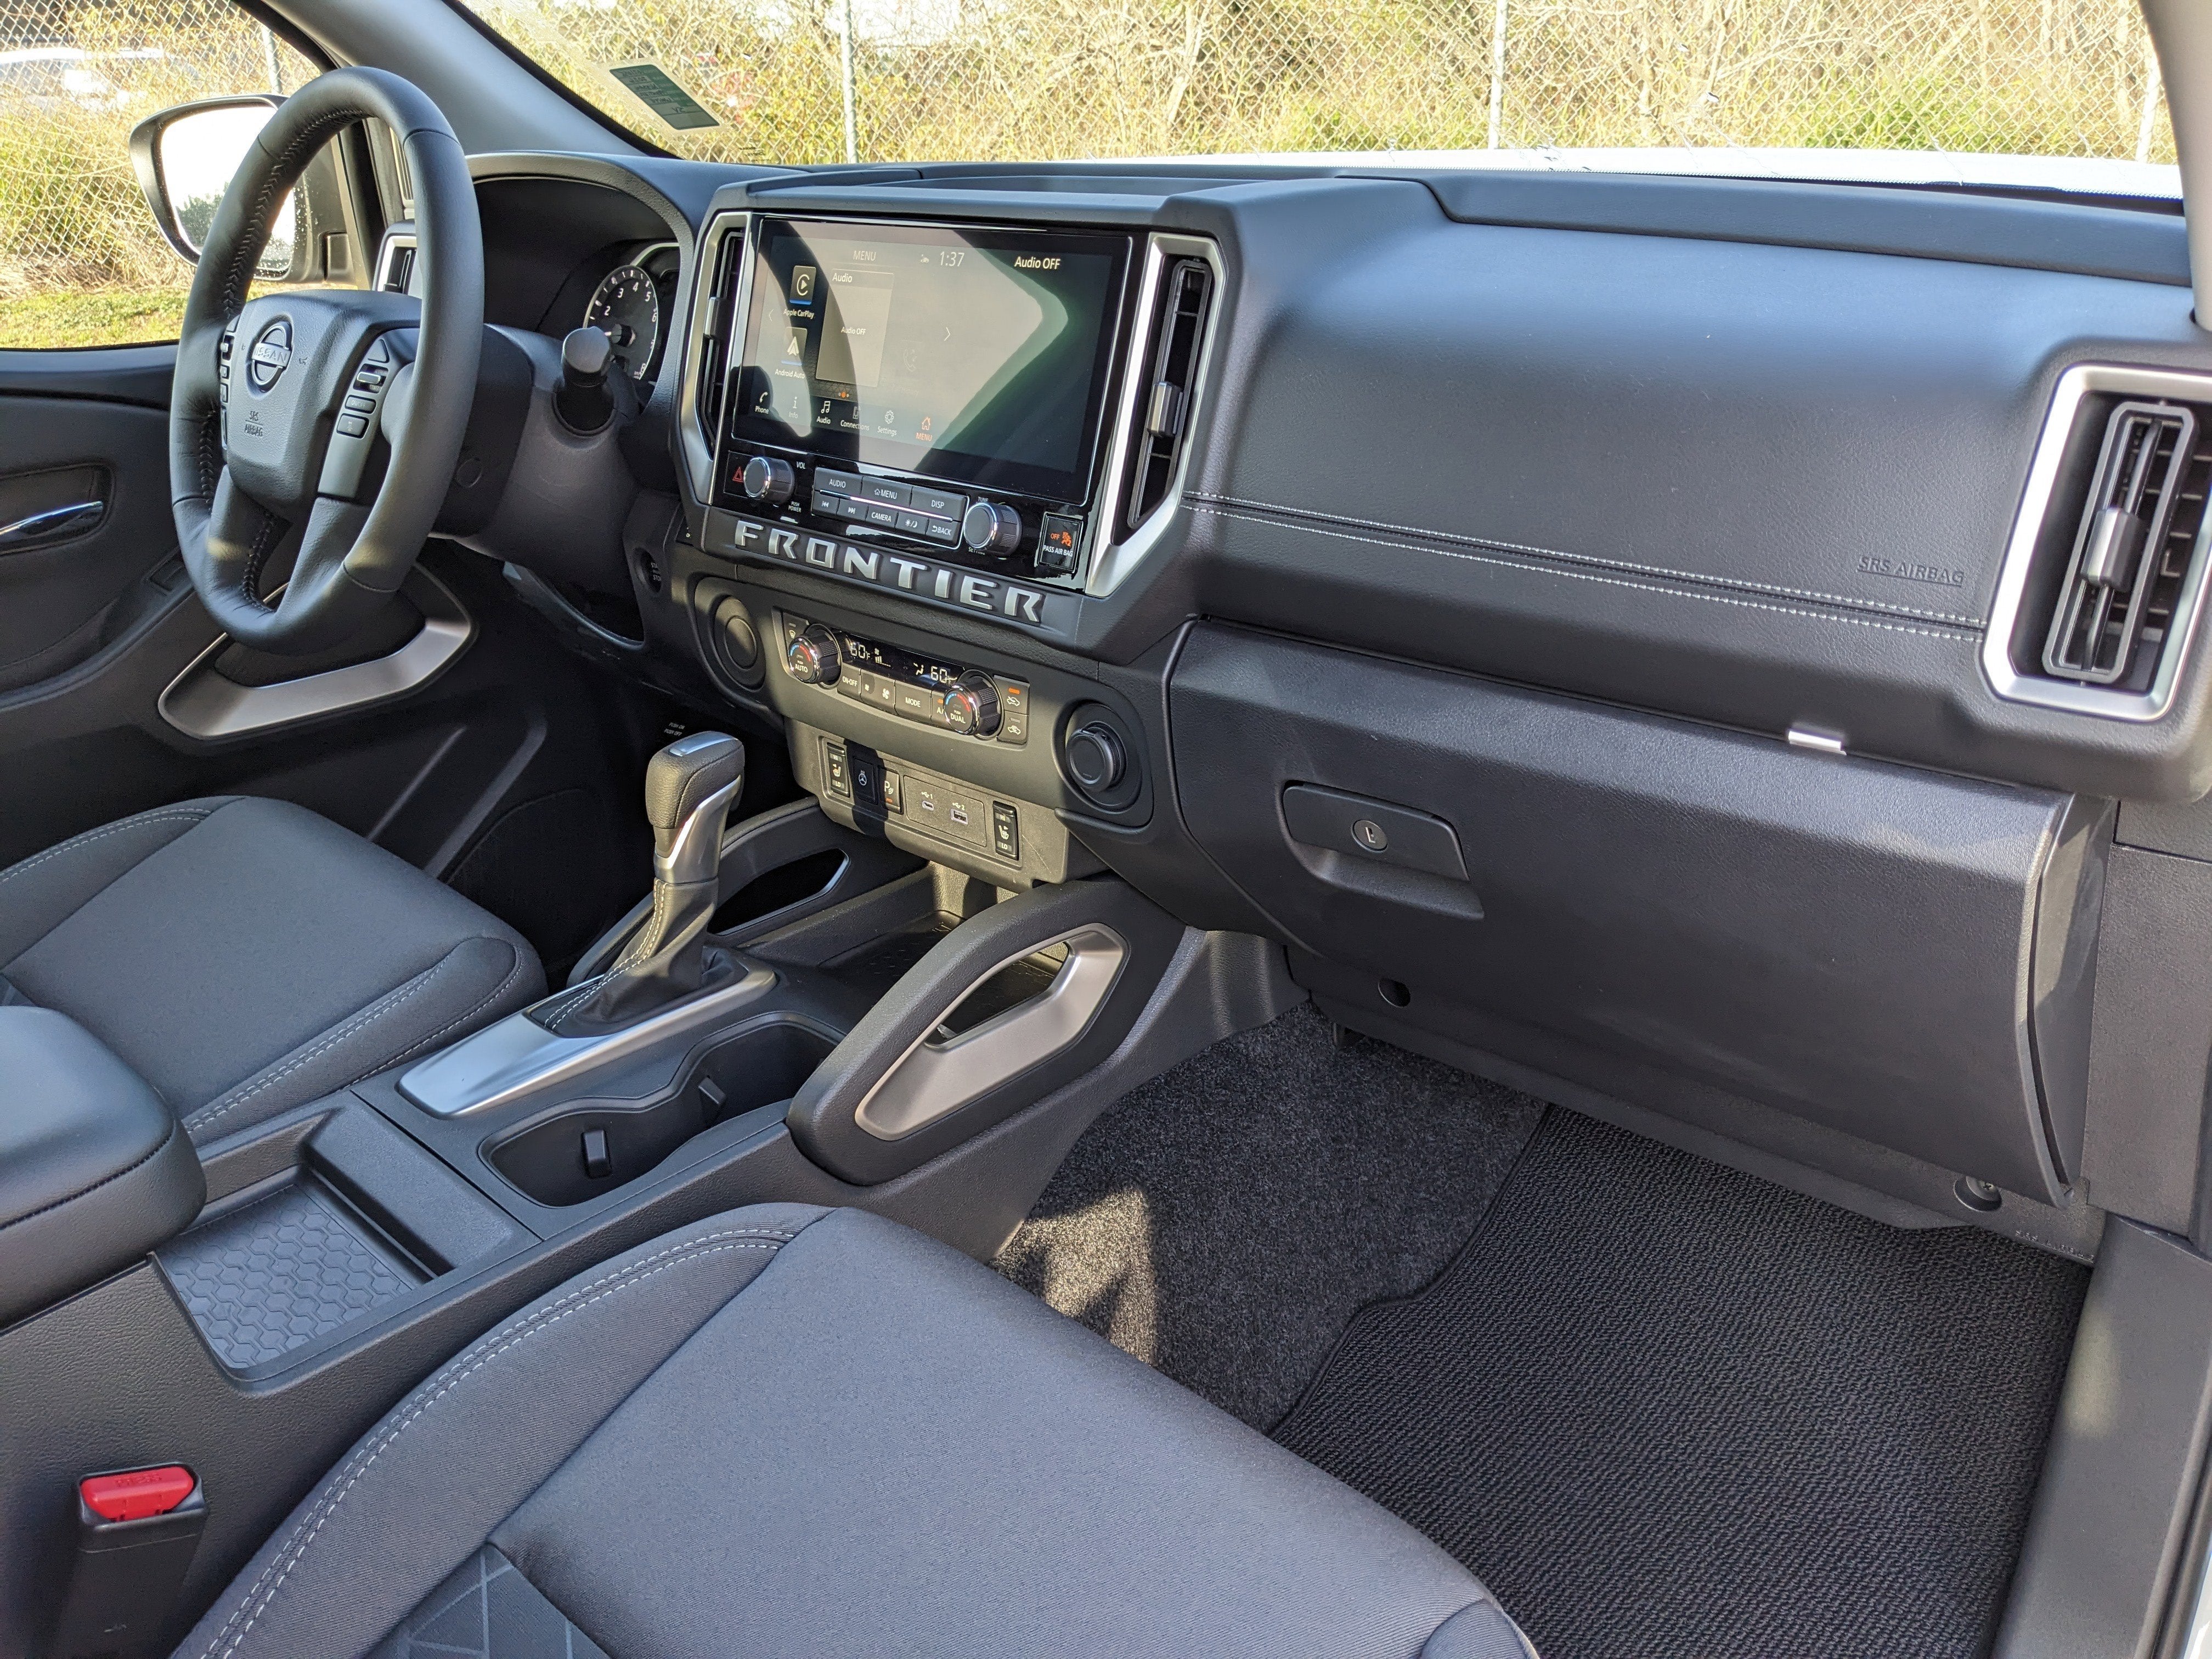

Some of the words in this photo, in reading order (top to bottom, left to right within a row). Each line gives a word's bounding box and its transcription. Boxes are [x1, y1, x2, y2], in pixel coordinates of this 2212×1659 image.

[853, 250, 877, 261] MENU
[939, 251, 965, 267] 1:37
[1014, 256, 1041, 269] Audio
[1042, 258, 1060, 270] OFF
[832, 273, 853, 283] Audio
[633, 282, 639, 292] 4
[618, 288, 624, 298] 3
[645, 291, 652, 302] 5
[604, 306, 611, 316] 2
[783, 308, 797, 317] Apple
[797, 309, 815, 320] CarPlay
[253, 345, 288, 363] NISSAN
[775, 368, 793, 377] Android
[794, 371, 805, 380] Auto
[754, 405, 769, 414] Phone
[788, 411, 798, 419] Info
[816, 416, 831, 425] Audio
[840, 420, 870, 431] Connections
[877, 426, 898, 436] Settings
[916, 432, 933, 442] MENU
[796, 461, 806, 470] VOL
[828, 479, 846, 488] AUDIO
[880, 489, 898, 499] MENU
[931, 500, 945, 509] DISP
[871, 512, 891, 522] CAMERA
[937, 526, 952, 537] BACK
[1050, 532, 1060, 540] OFF
[1043, 544, 1054, 554] PASS
[1054, 547, 1063, 555] AIR
[1063, 549, 1074, 558] BAG
[735, 520, 1042, 623] FRONTIER
[1858, 556, 1891, 574] SRS
[1894, 560, 1966, 585] AIRBAG
[795, 663, 808, 673] AUTO
[842, 676, 858, 687] ON-OFF
[905, 697, 921, 708] MODE
[950, 713, 966, 724] DUAL
